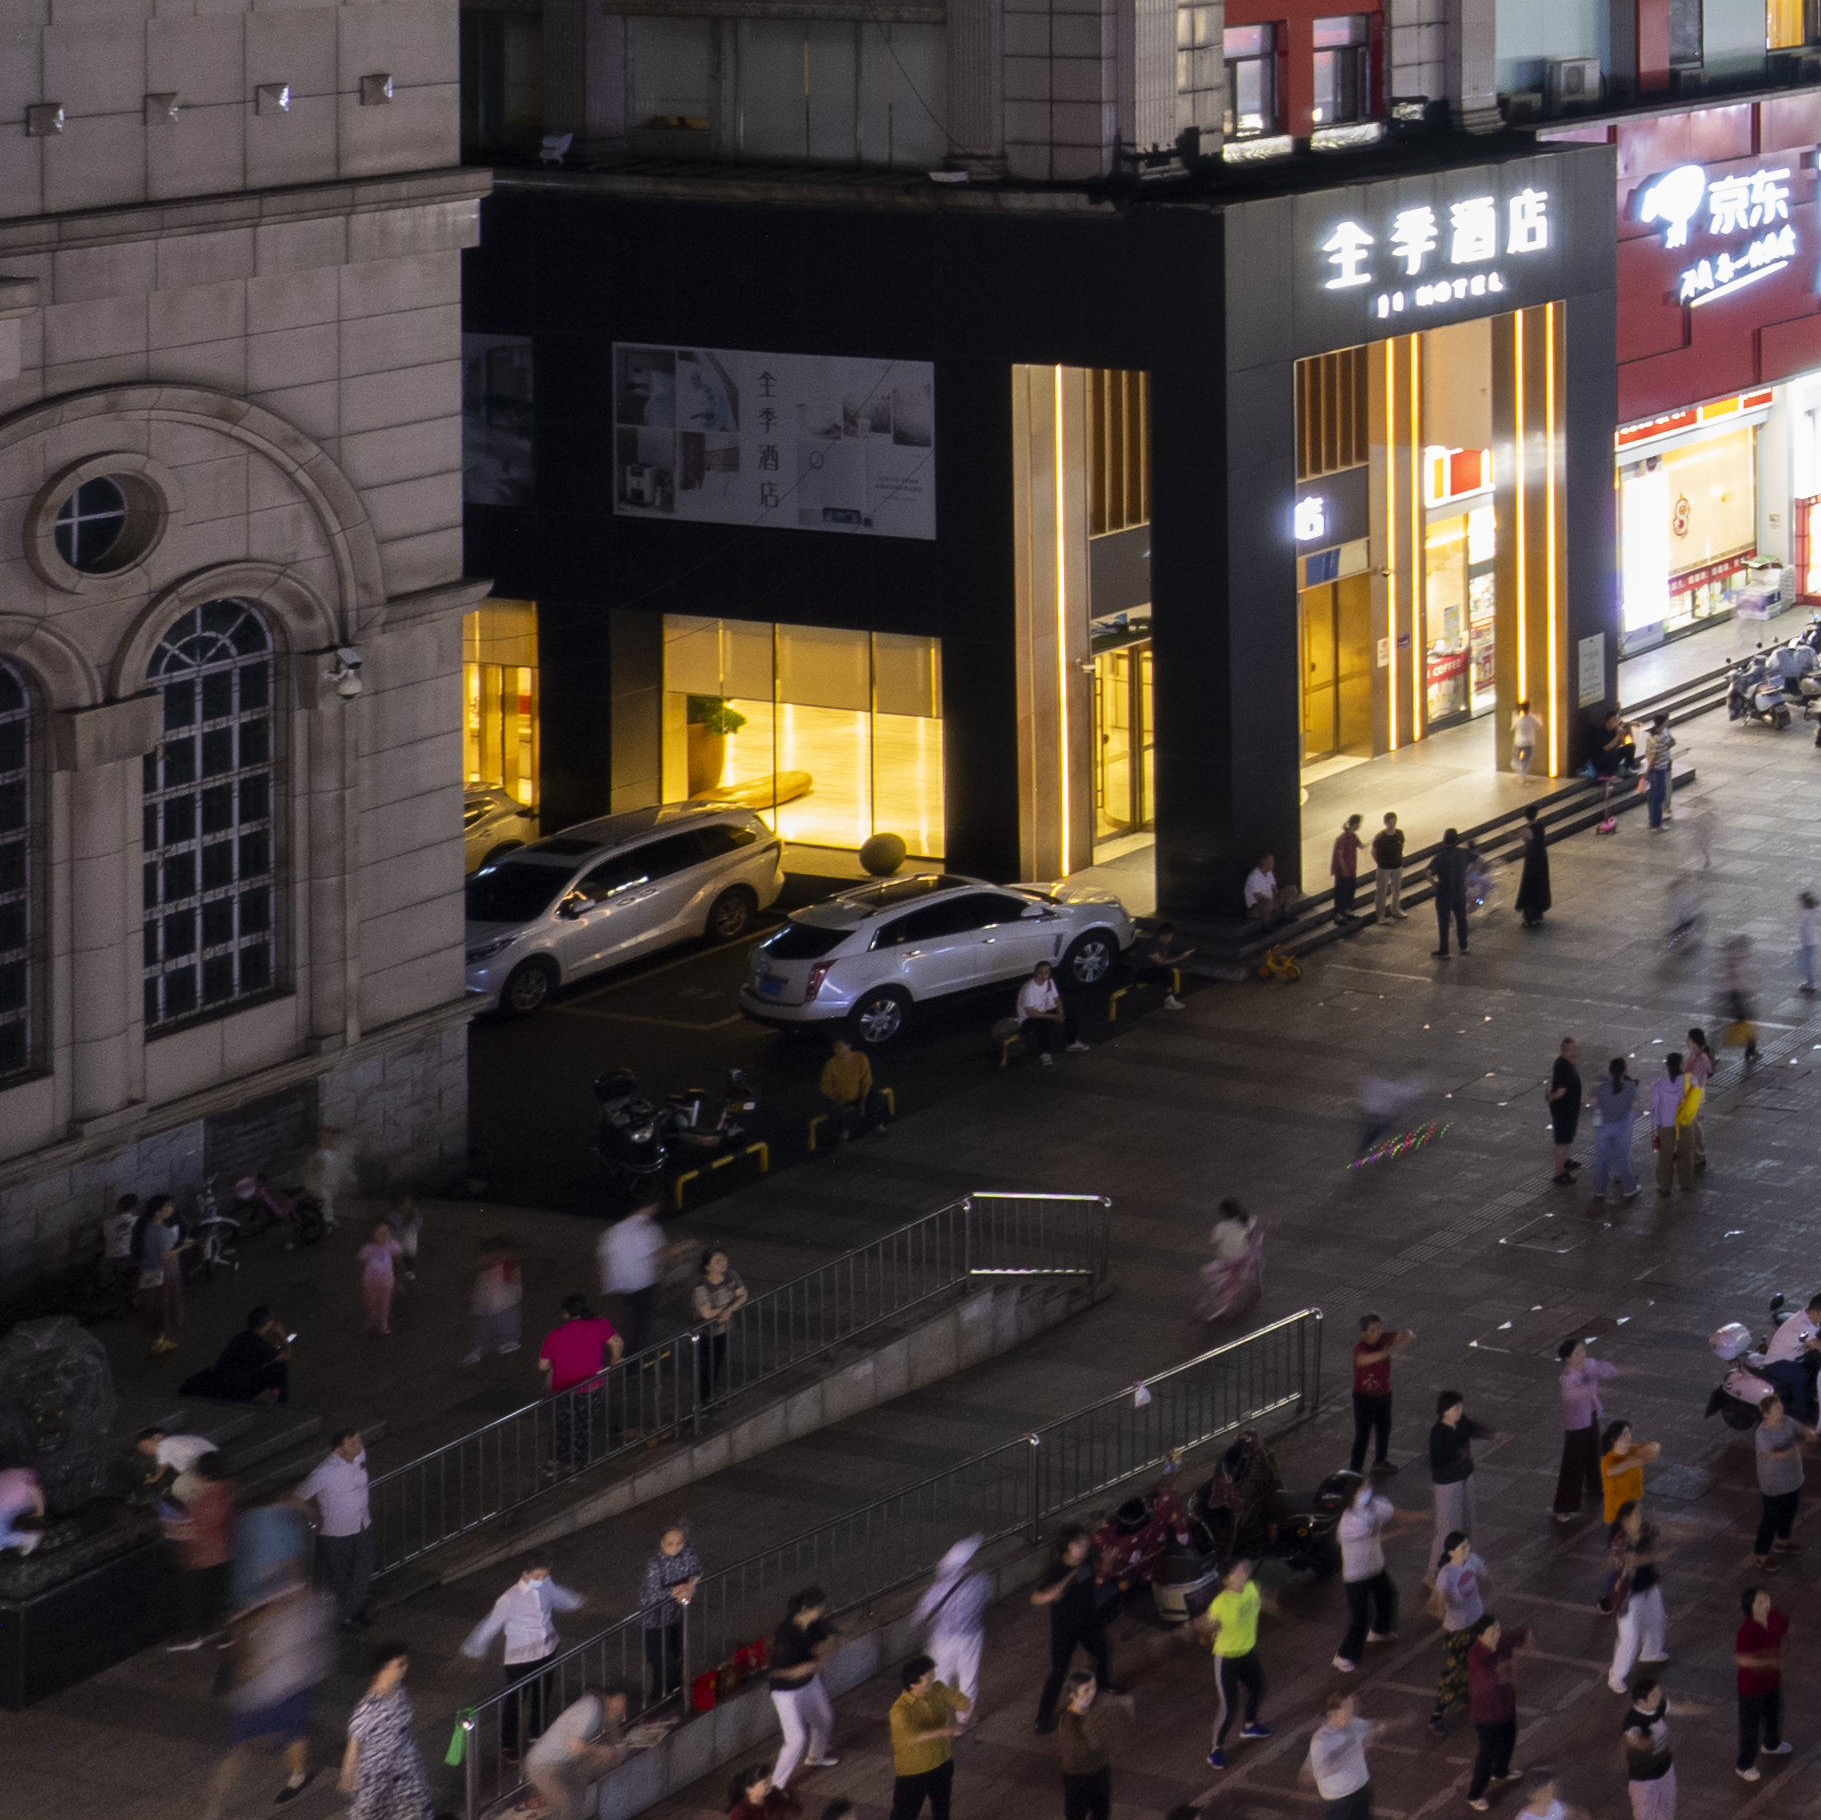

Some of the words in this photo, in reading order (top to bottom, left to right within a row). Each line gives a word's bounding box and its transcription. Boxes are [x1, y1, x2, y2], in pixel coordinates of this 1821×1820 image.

[1321, 187, 1549, 289] 全季酒店
[1708, 167, 1791, 235] 京东
[1415, 272, 1505, 307] HOTEL
[756, 369, 781, 510] 全季酒店
